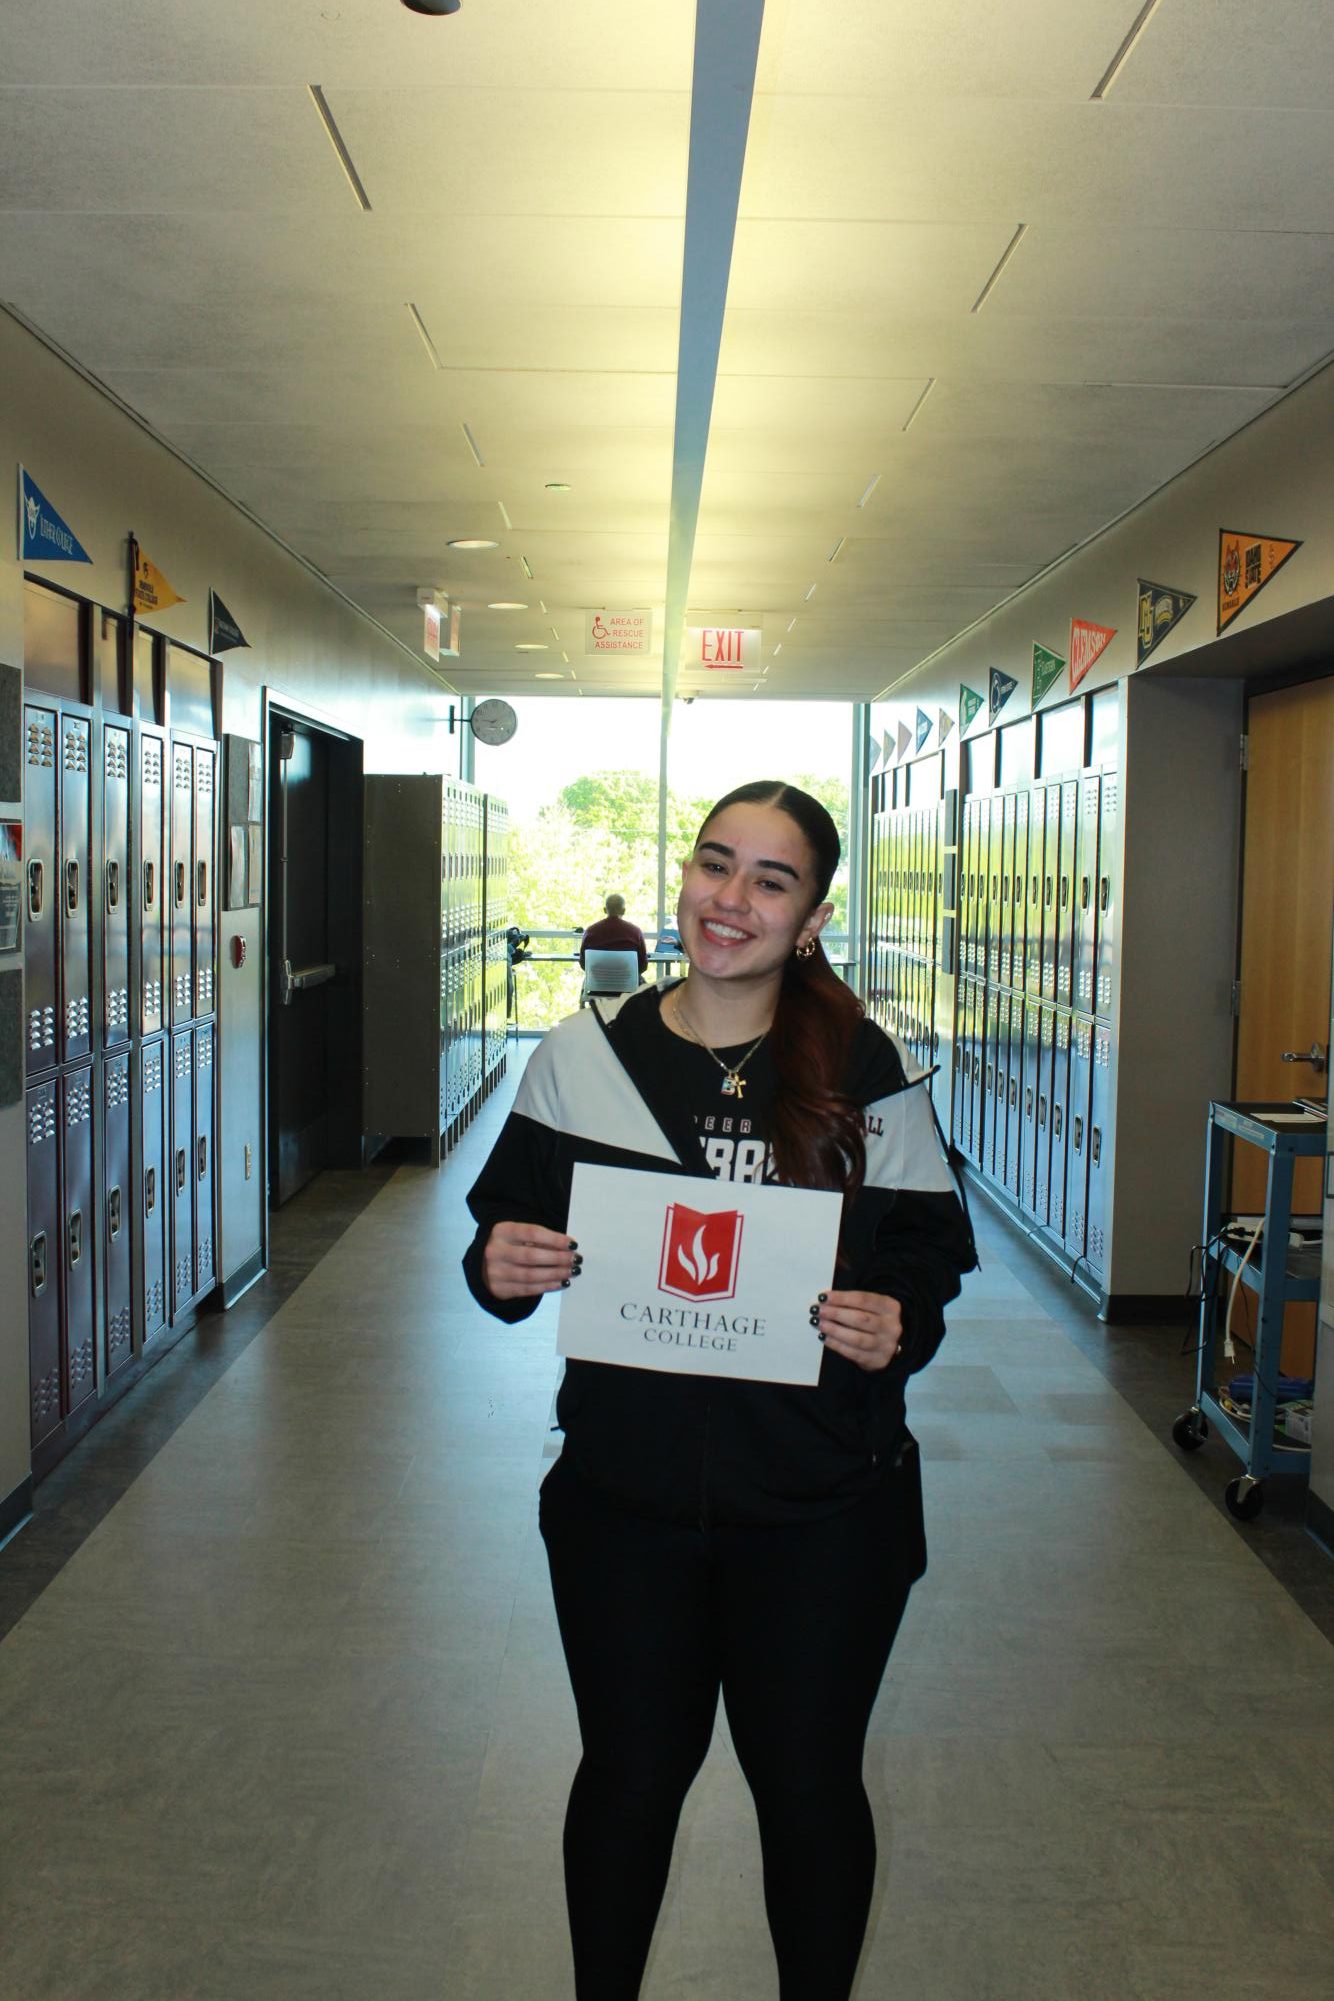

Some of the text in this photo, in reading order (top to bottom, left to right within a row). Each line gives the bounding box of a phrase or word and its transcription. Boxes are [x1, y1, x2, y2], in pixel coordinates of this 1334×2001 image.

[610, 617, 645, 626] AREA OF
[612, 629, 645, 638] RESCUE
[595, 641, 644, 650] ASSISTANCE
[702, 630, 744, 662] EXIT
[867, 1116, 885, 1137] LL
[620, 1302, 767, 1337] CARTHAGE
[643, 1329, 738, 1352] COLLEGE
